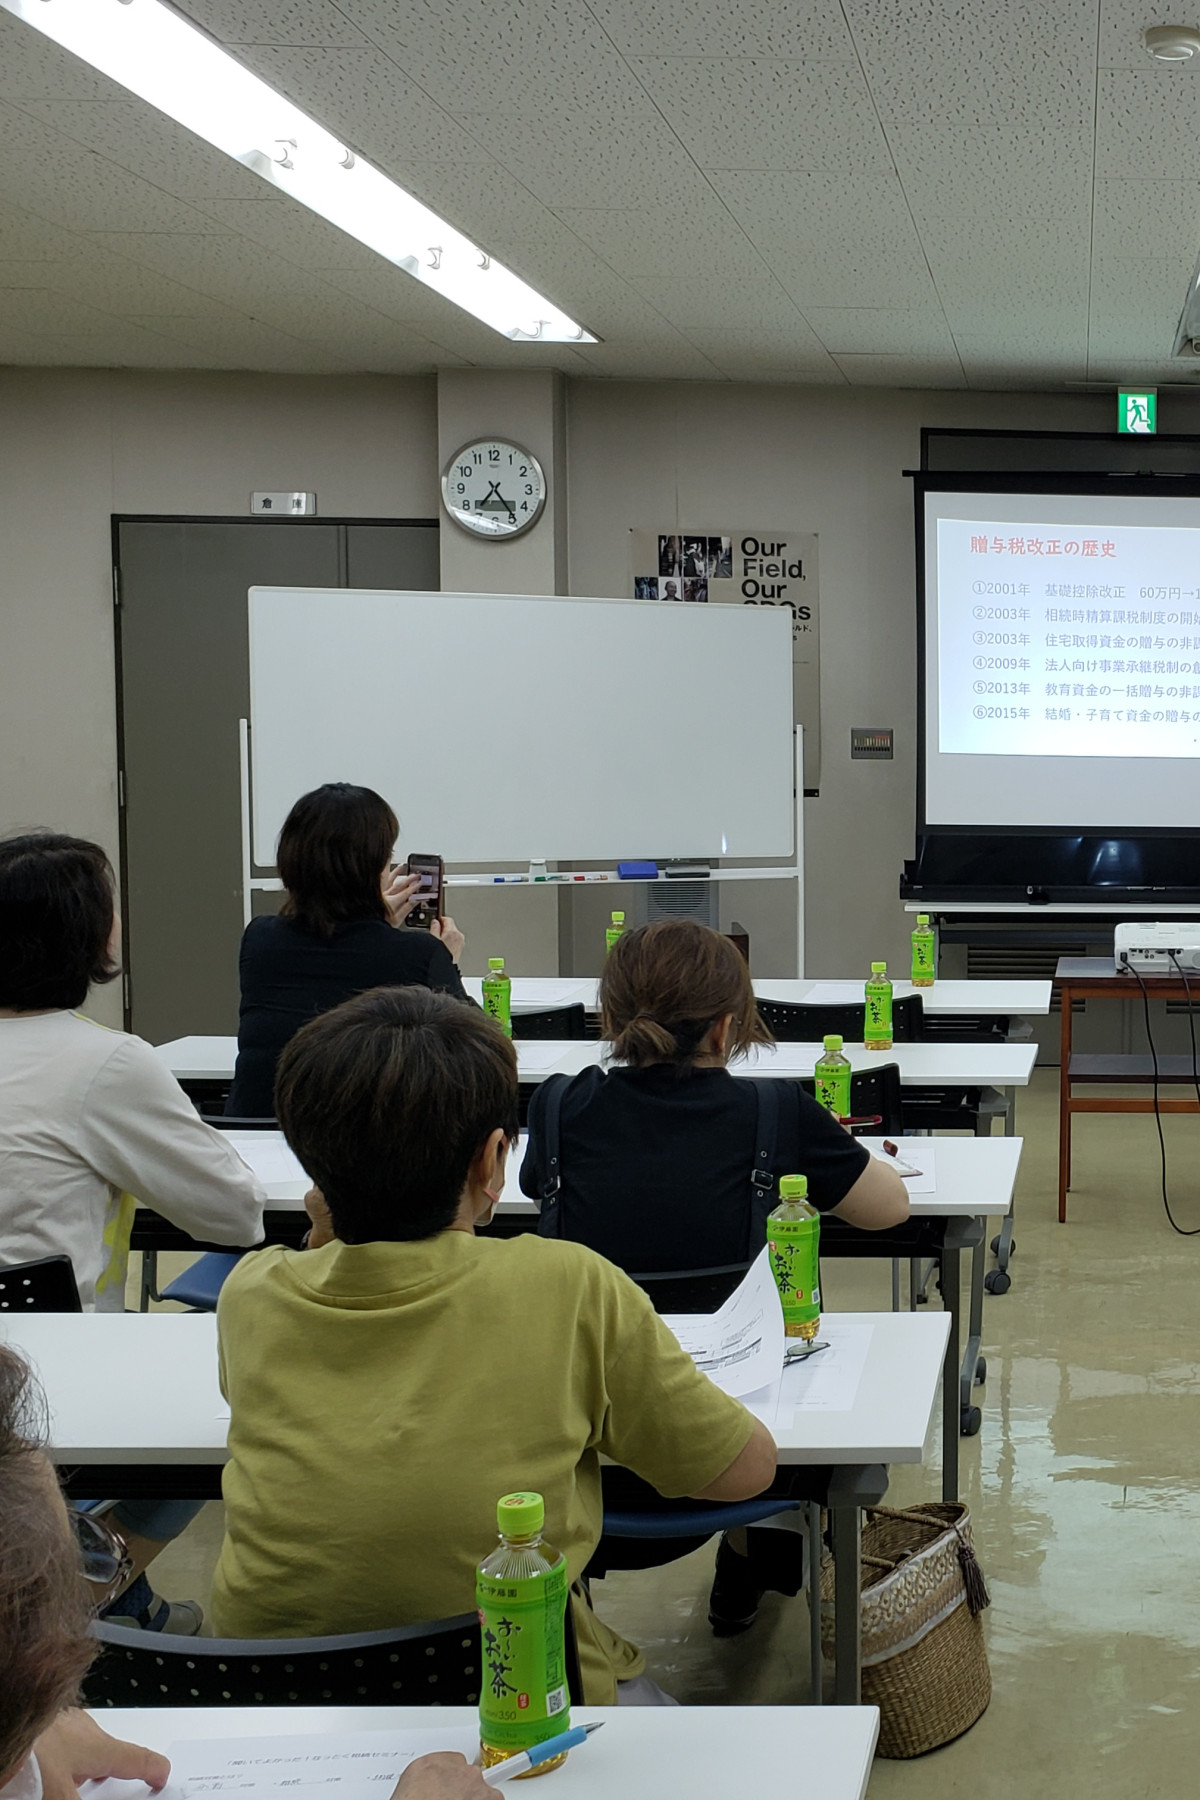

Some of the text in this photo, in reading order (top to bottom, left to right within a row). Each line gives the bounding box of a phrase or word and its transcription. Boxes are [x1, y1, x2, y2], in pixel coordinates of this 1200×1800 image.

[473, 453, 482, 464] 11
[488, 450, 500, 461] 12
[508, 454, 513, 465] 1
[459, 466, 472, 477] 10
[519, 466, 527, 477] 2
[456, 483, 465, 494] 9
[524, 484, 533, 495] 3
[462, 500, 470, 511] 8
[520, 501, 528, 512] 4
[741, 537, 787, 557] Our
[970, 536, 1117, 558] 贈与税改正の歴史
[743, 559, 806, 581] Field,
[741, 579, 787, 599] Our
[972, 580, 1031, 597] ①2001年
[1044, 583, 1126, 599] 基礎控除改正
[972, 605, 1031, 621] ②2003年
[972, 630, 1031, 646] ③2003年
[972, 655, 1031, 671] ④2009年
[972, 679, 1031, 695] ⑤2013年
[972, 704, 1031, 720] ⑥2015年
[484, 1627, 518, 1699] お茶
